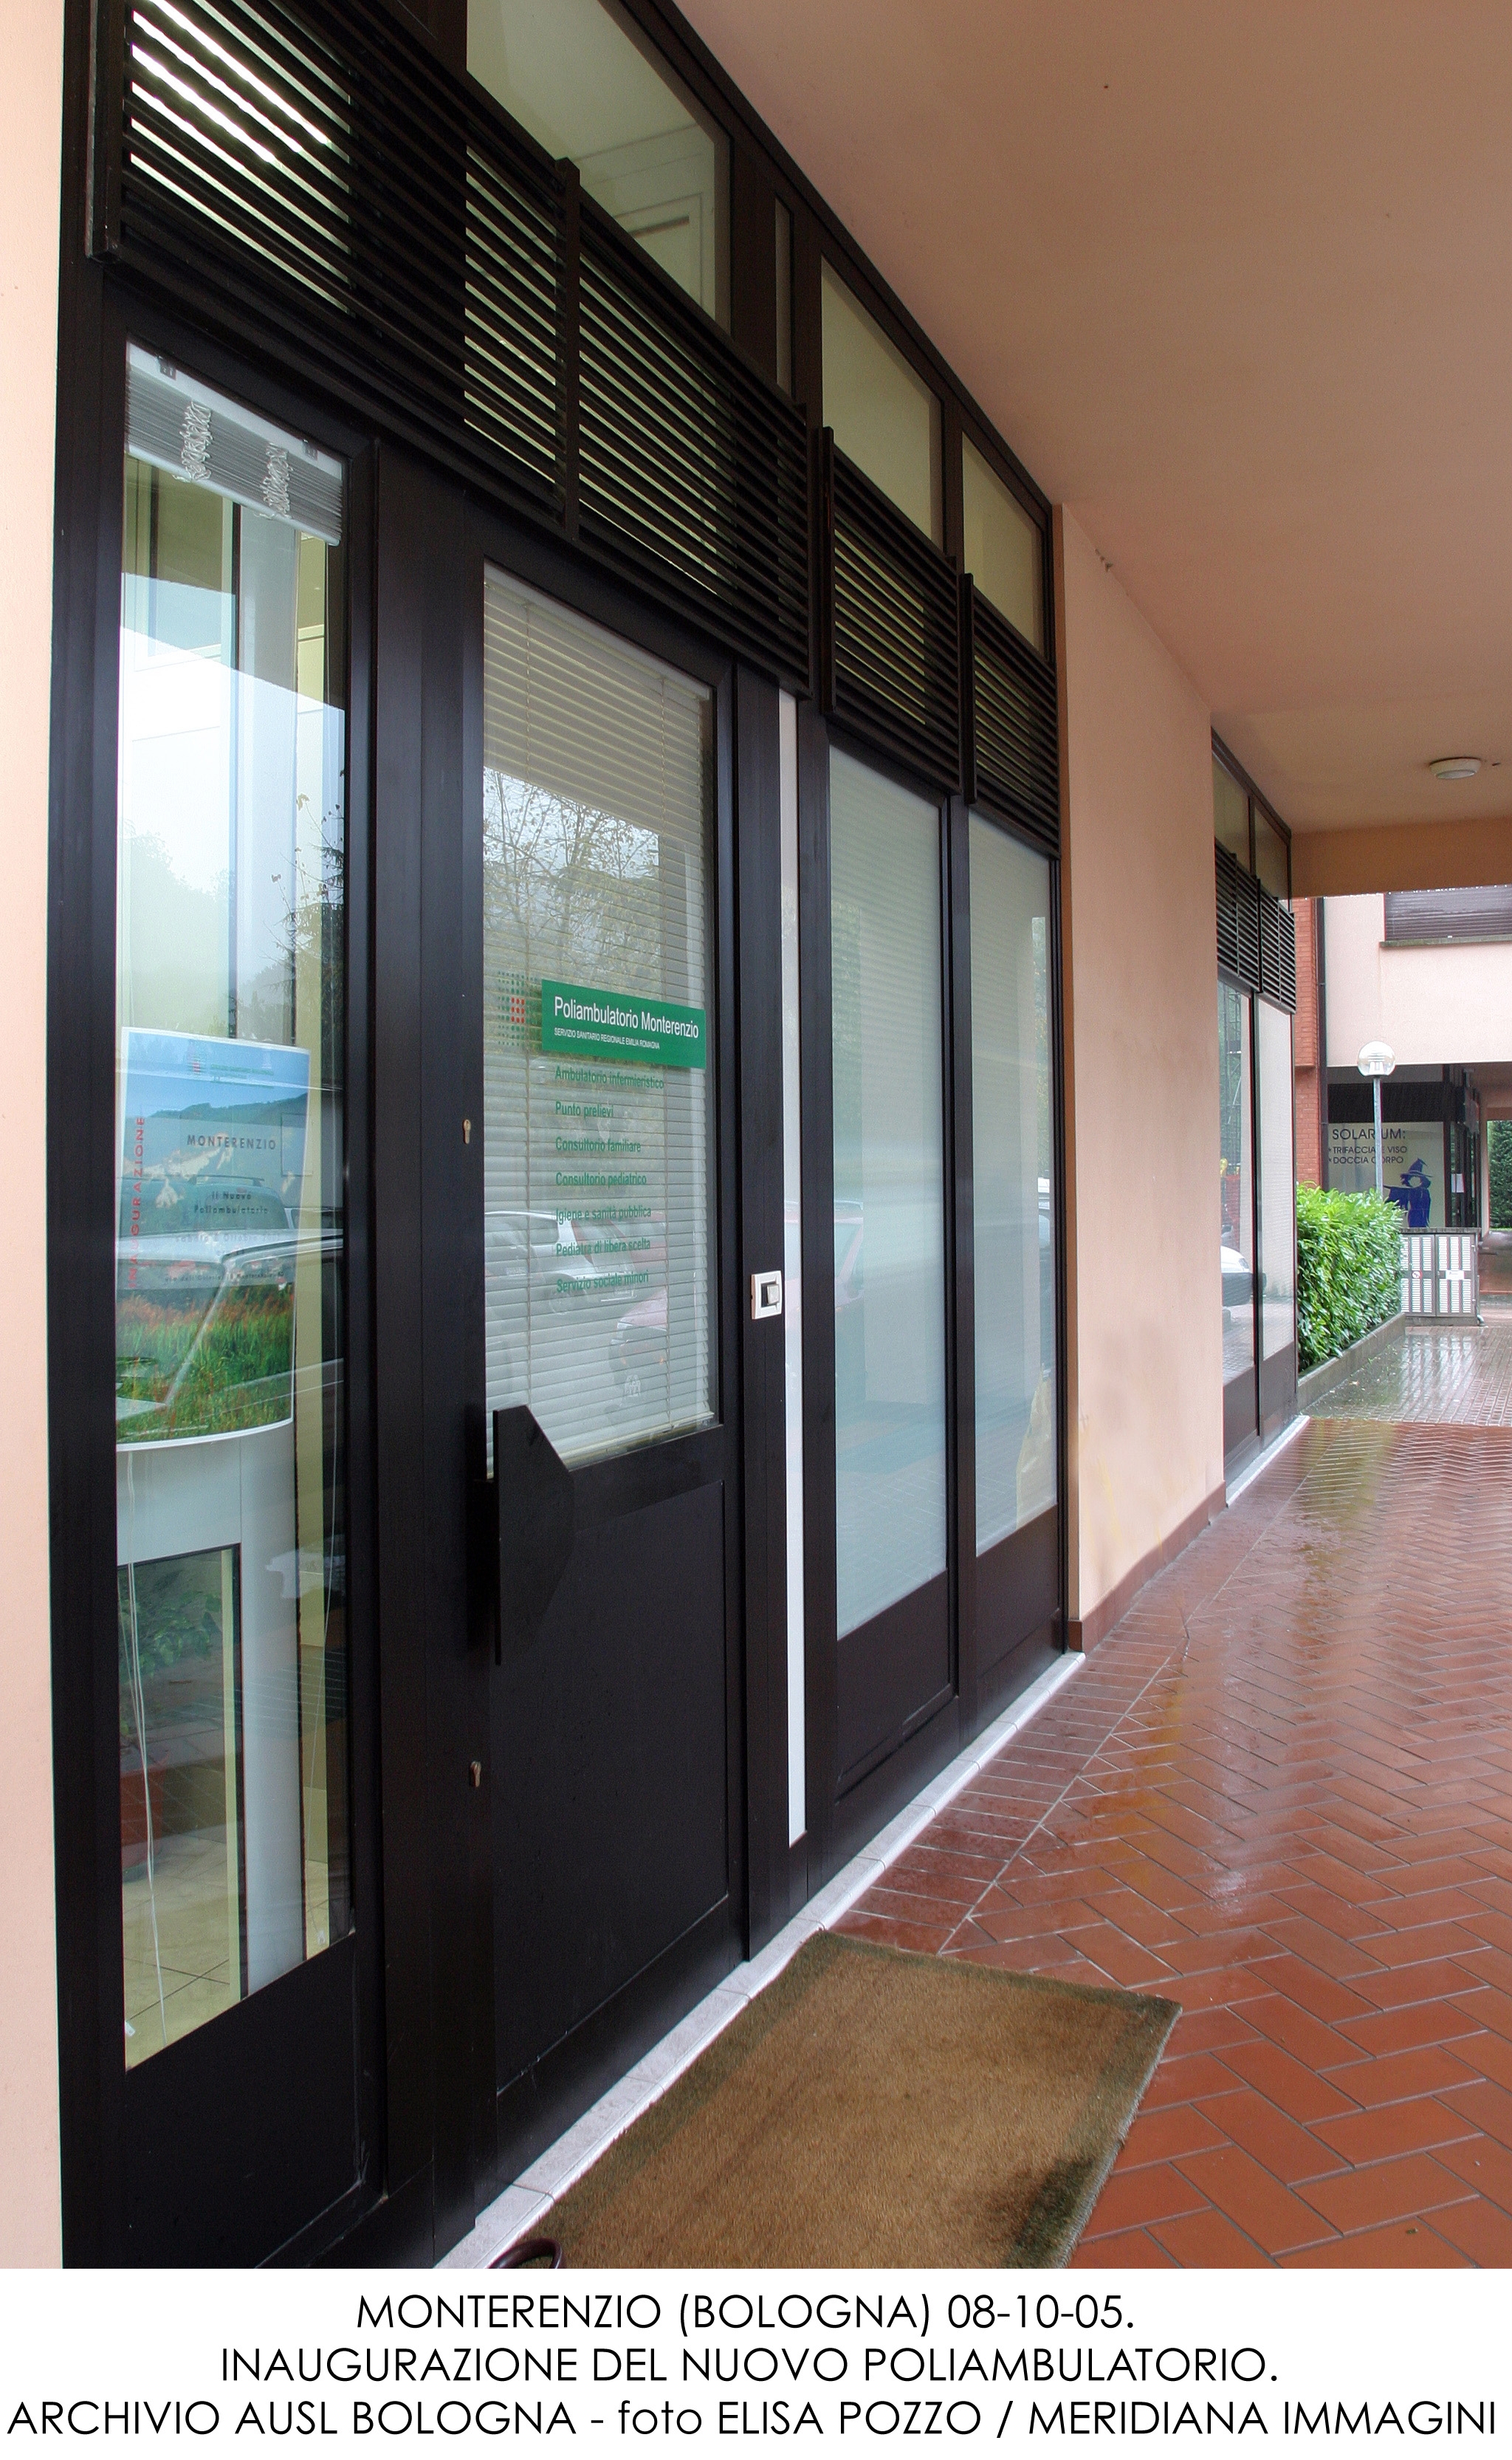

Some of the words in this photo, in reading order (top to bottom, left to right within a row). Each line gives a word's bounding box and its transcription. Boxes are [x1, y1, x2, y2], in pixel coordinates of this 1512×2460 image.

[554, 996, 639, 1029] Poliambulatorio
[641, 1011, 699, 1038] Monterenzio
[554, 1027, 577, 1038] SERVIZIO
[577, 1030, 600, 1041] SANITARIO
[600, 1033, 625, 1045] REGIONALE
[625, 1038, 639, 1046] EMILIA
[639, 1039, 660, 1049] ROMAGNA
[555, 1065, 608, 1084] Ambulatorio
[609, 1071, 664, 1089] infermieristico
[555, 1100, 581, 1117] Punto
[583, 1104, 614, 1120] prelievi
[187, 1134, 276, 1150] MONTERENZIO
[1332, 1128, 1406, 1140] SOLARUM:
[555, 1136, 605, 1152] Consultorio
[608, 1137, 642, 1152] familiare
[1387, 1145, 1408, 1154] VISO
[1333, 1156, 1369, 1165] DOCCIA
[555, 1171, 605, 1186] Consultorio
[608, 1171, 647, 1188] pediatrico
[556, 1207, 582, 1225] Igiene
[591, 1205, 616, 1220] sanità
[619, 1205, 652, 1222] pubblica
[594, 1240, 602, 1254] di
[604, 1238, 627, 1253] libera
[628, 1237, 650, 1250] scelta
[556, 1276, 591, 1293] Servizio
[594, 1272, 622, 1288] sociale
[624, 1270, 649, 1284] minori
